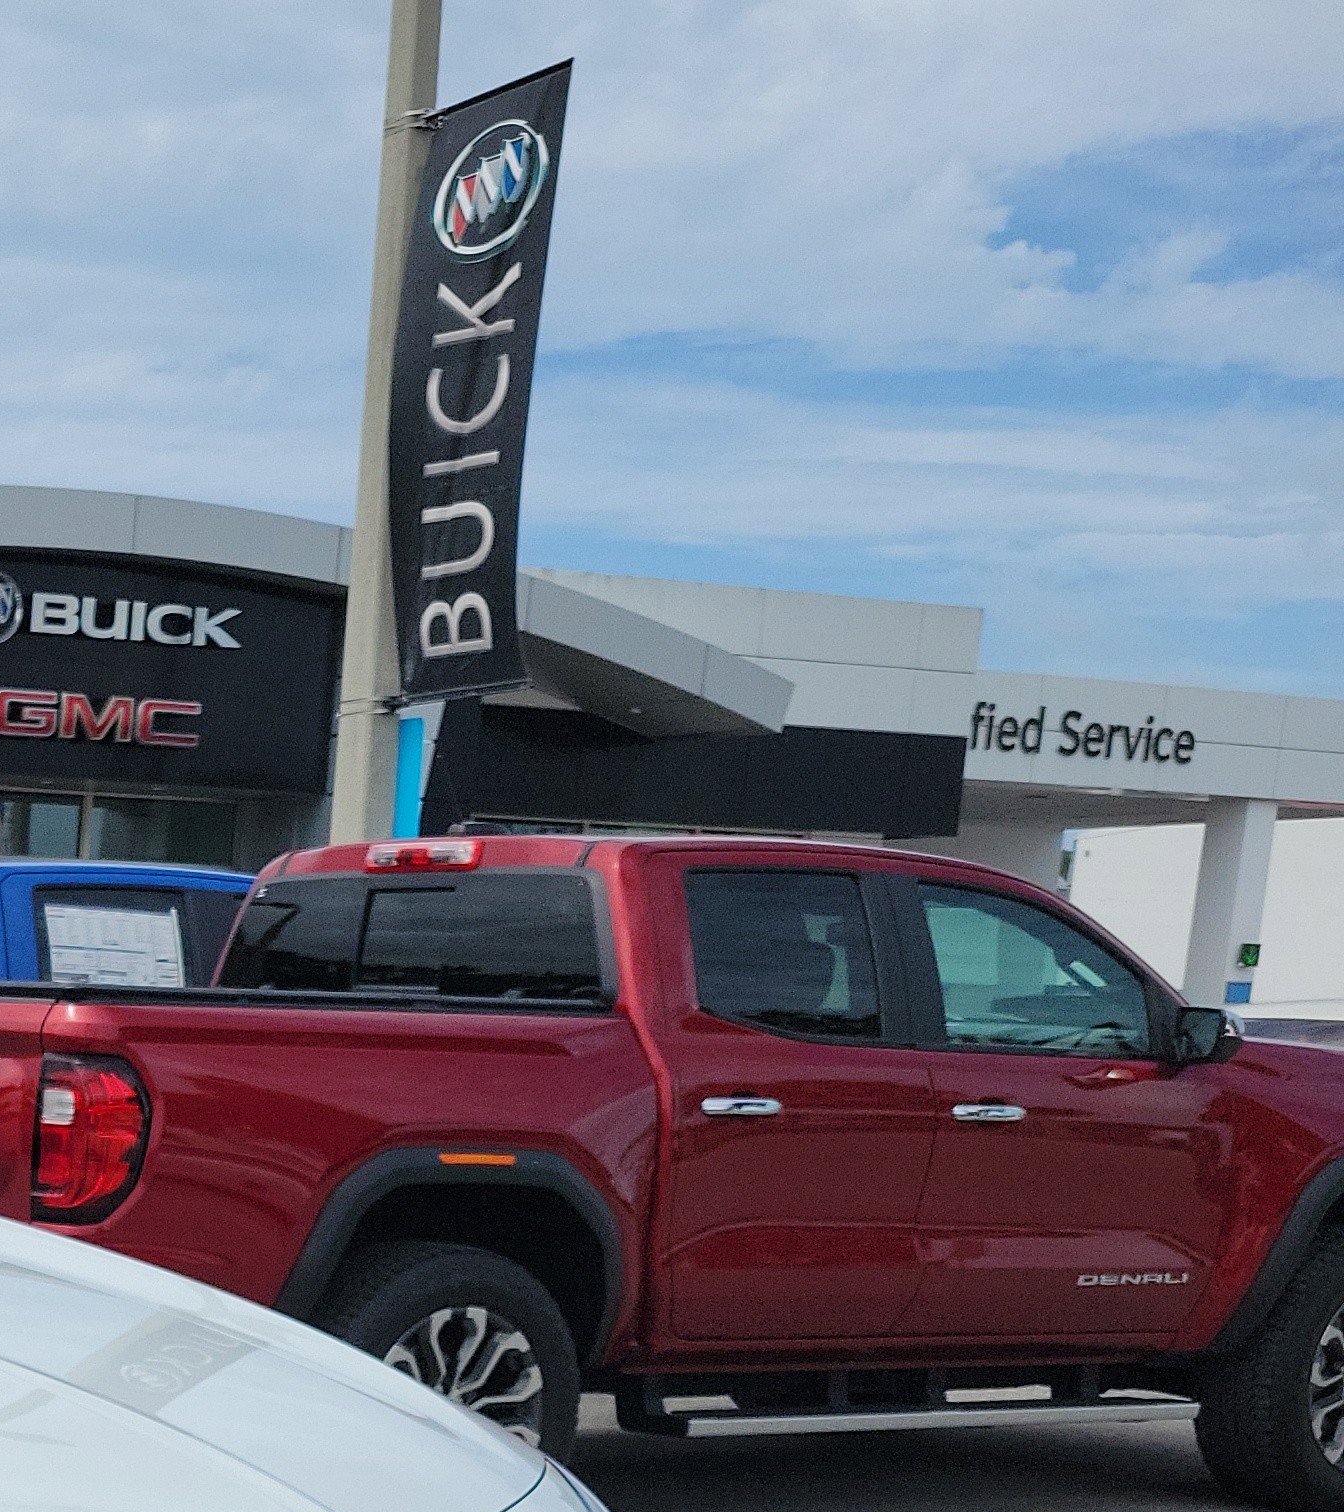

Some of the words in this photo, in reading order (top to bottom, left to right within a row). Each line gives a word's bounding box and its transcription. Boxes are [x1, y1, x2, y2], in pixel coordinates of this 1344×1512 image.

[419, 262, 522, 659] BUICK
[30, 591, 243, 649] BUICK
[1057, 710, 1196, 765] Service
[1076, 1272, 1189, 1287] DENALI
